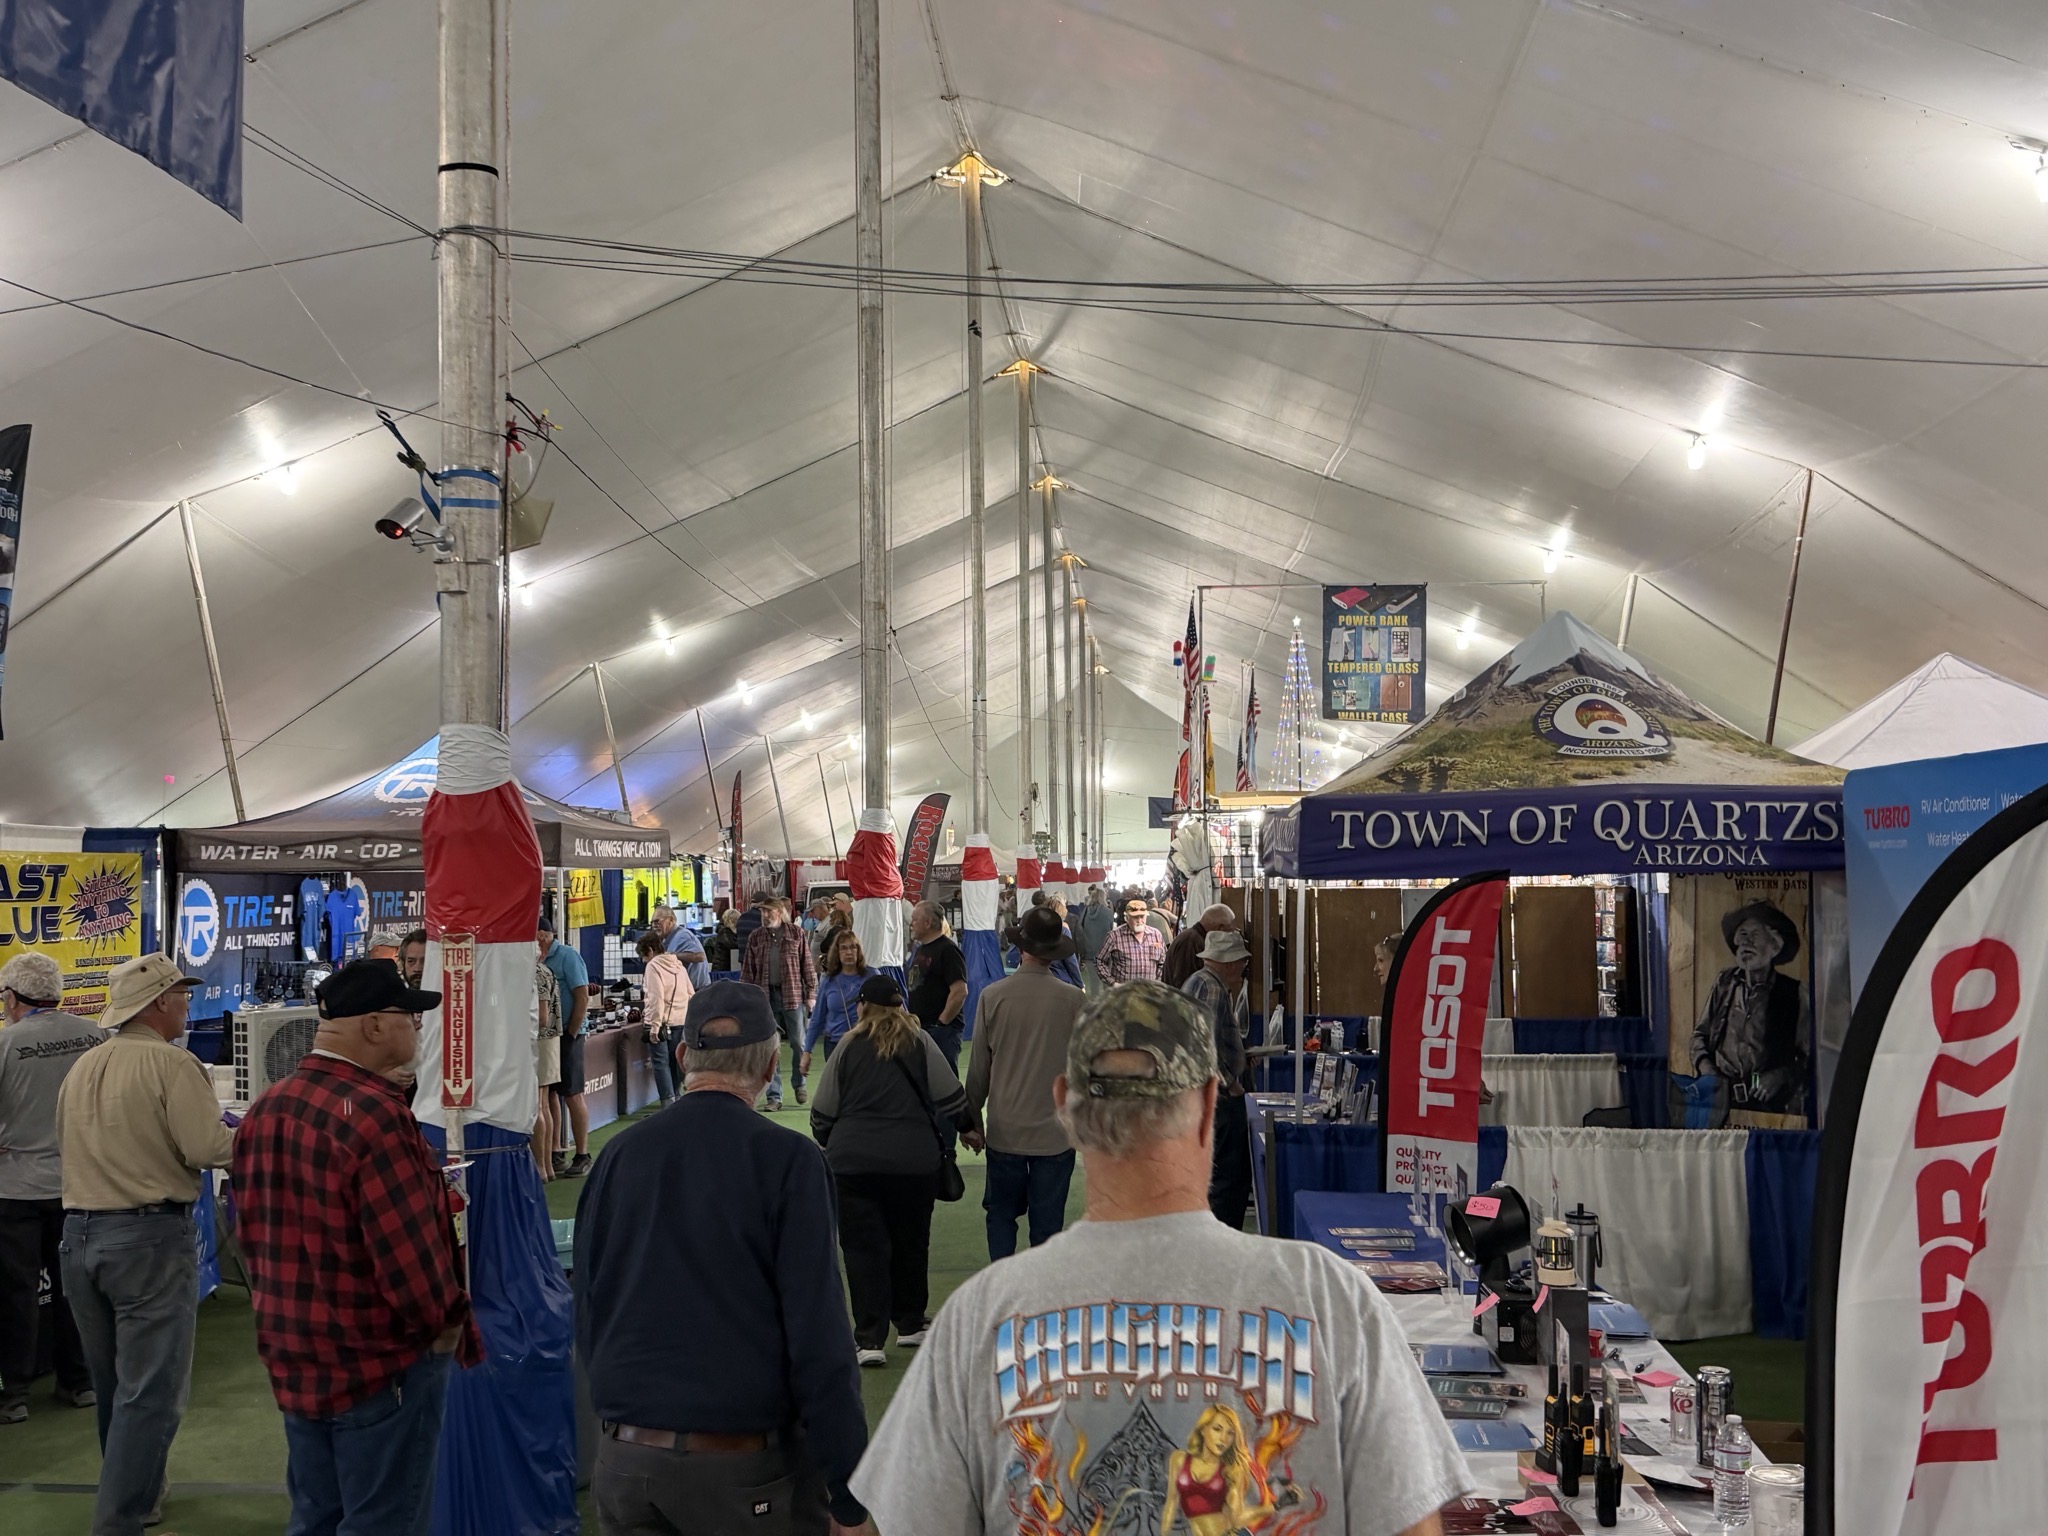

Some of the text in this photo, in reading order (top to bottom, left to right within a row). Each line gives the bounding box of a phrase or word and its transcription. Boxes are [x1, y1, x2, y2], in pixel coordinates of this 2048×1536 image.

[1338, 615, 1409, 626] POWER BANK
[1327, 662, 1419, 674] TEMPERED GLASS
[1551, 677, 1600, 695] FOUNDED
[1573, 684, 1592, 695] OF
[1545, 691, 1572, 719] TOWN
[1337, 711, 1408, 723] WALLET CASE
[1538, 716, 1554, 734] THE
[1563, 747, 1645, 755] INCORPORATED
[1580, 739, 1646, 748] ARIZONA
[1921, 796, 1990, 814] RV Air Conditioner
[1330, 808, 1493, 850] TOWN
[1508, 803, 1579, 846] OF
[1592, 799, 1844, 852] QUARTZS
[1864, 805, 1911, 831] TURBRO
[574, 838, 661, 858] ALL THINGS INFLATION
[1927, 831, 1971, 848] Water Heat
[200, 845, 280, 860] WATER
[299, 844, 338, 859] AIR
[359, 843, 403, 859] CO2
[1633, 844, 1770, 867] ARIZONA
[0, 863, 69, 902] AST
[84, 873, 119, 893] STICKS
[1735, 878, 1808, 891] WESTERN DAYS
[75, 885, 128, 910] ANYTHING
[372, 890, 426, 918] TIRE-RIT
[94, 903, 110, 919] TO
[223, 894, 294, 930] TIRE-R
[78, 911, 132, 938] ANYTHING
[386, 921, 408, 935] THINGS
[224, 935, 243, 951] ALL
[246, 933, 280, 948] THINGS
[443, 947, 471, 967] FIRE
[205, 985, 221, 1000] AIR
[1418, 916, 1472, 1118] TOSOT
[452, 969, 464, 1088] EXTINGUISHER
[584, 1072, 614, 1096] RITE.COM
[994, 1299, 1318, 1424] LAUGHLIN
[1065, 1380, 1220, 1399] NEVADA
[754, 1502, 769, 1515] CAT
